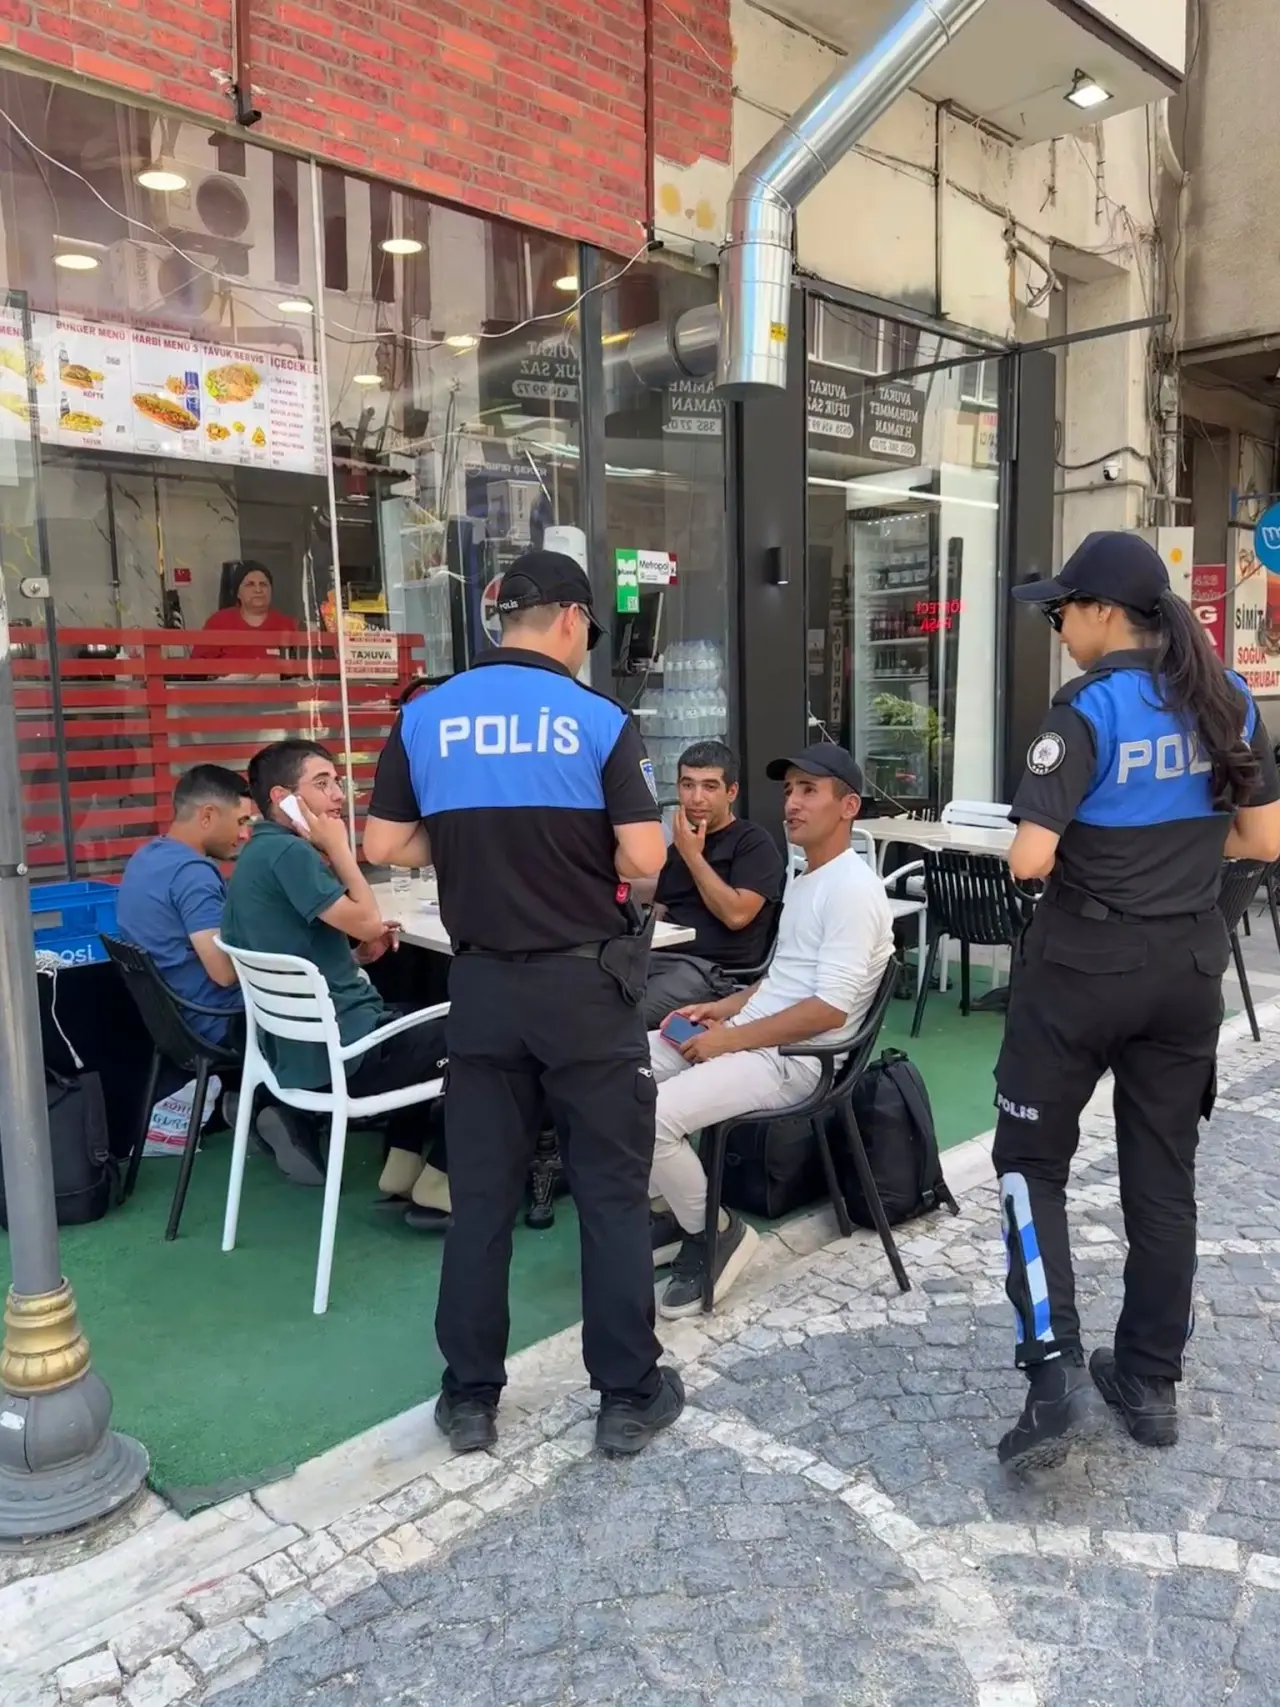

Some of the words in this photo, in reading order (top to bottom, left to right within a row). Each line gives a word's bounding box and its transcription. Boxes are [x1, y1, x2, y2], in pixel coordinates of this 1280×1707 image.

[56, 320, 96, 337] BURGER
[203, 344, 233, 360] TAVUK
[640, 560, 669, 571] Metropol
[439, 706, 580, 758] POLİS
[1117, 732, 1213, 784] POL
